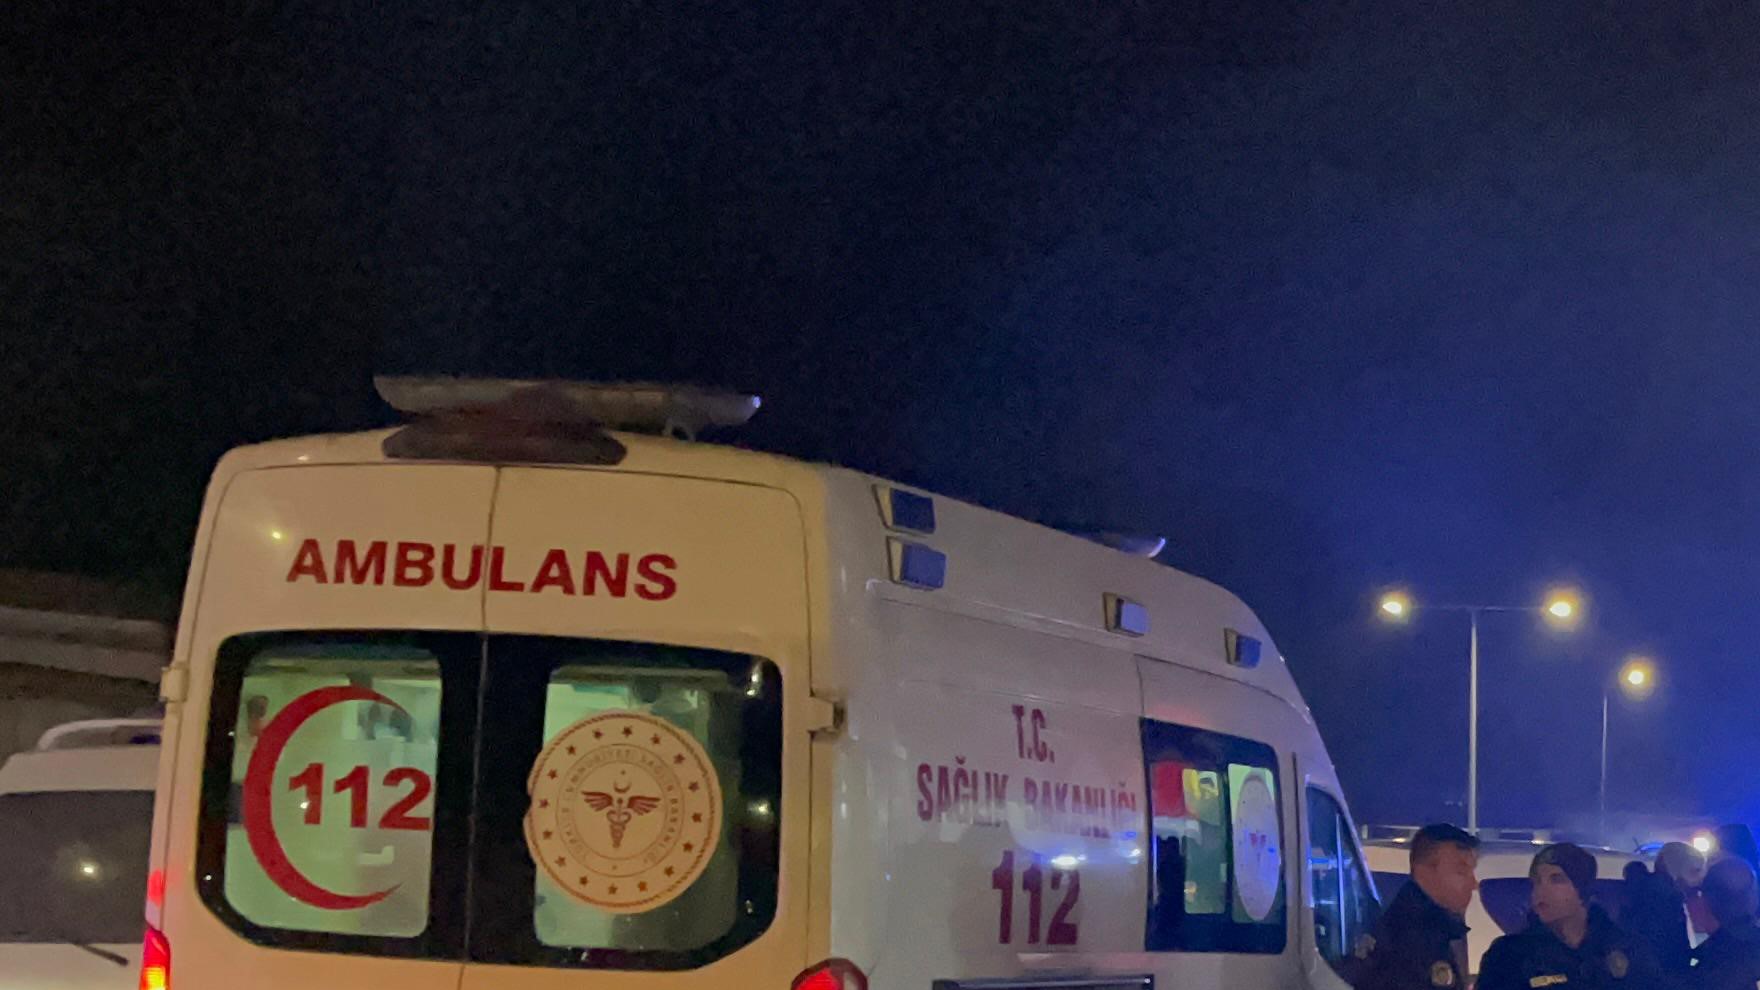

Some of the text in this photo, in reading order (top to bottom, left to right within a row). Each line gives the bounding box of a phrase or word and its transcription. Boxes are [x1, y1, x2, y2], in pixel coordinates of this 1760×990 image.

[286, 537, 678, 603] AMBULANS
[1011, 703, 1056, 764] T.C.
[287, 762, 432, 833] 112
[991, 850, 1081, 946] 112
